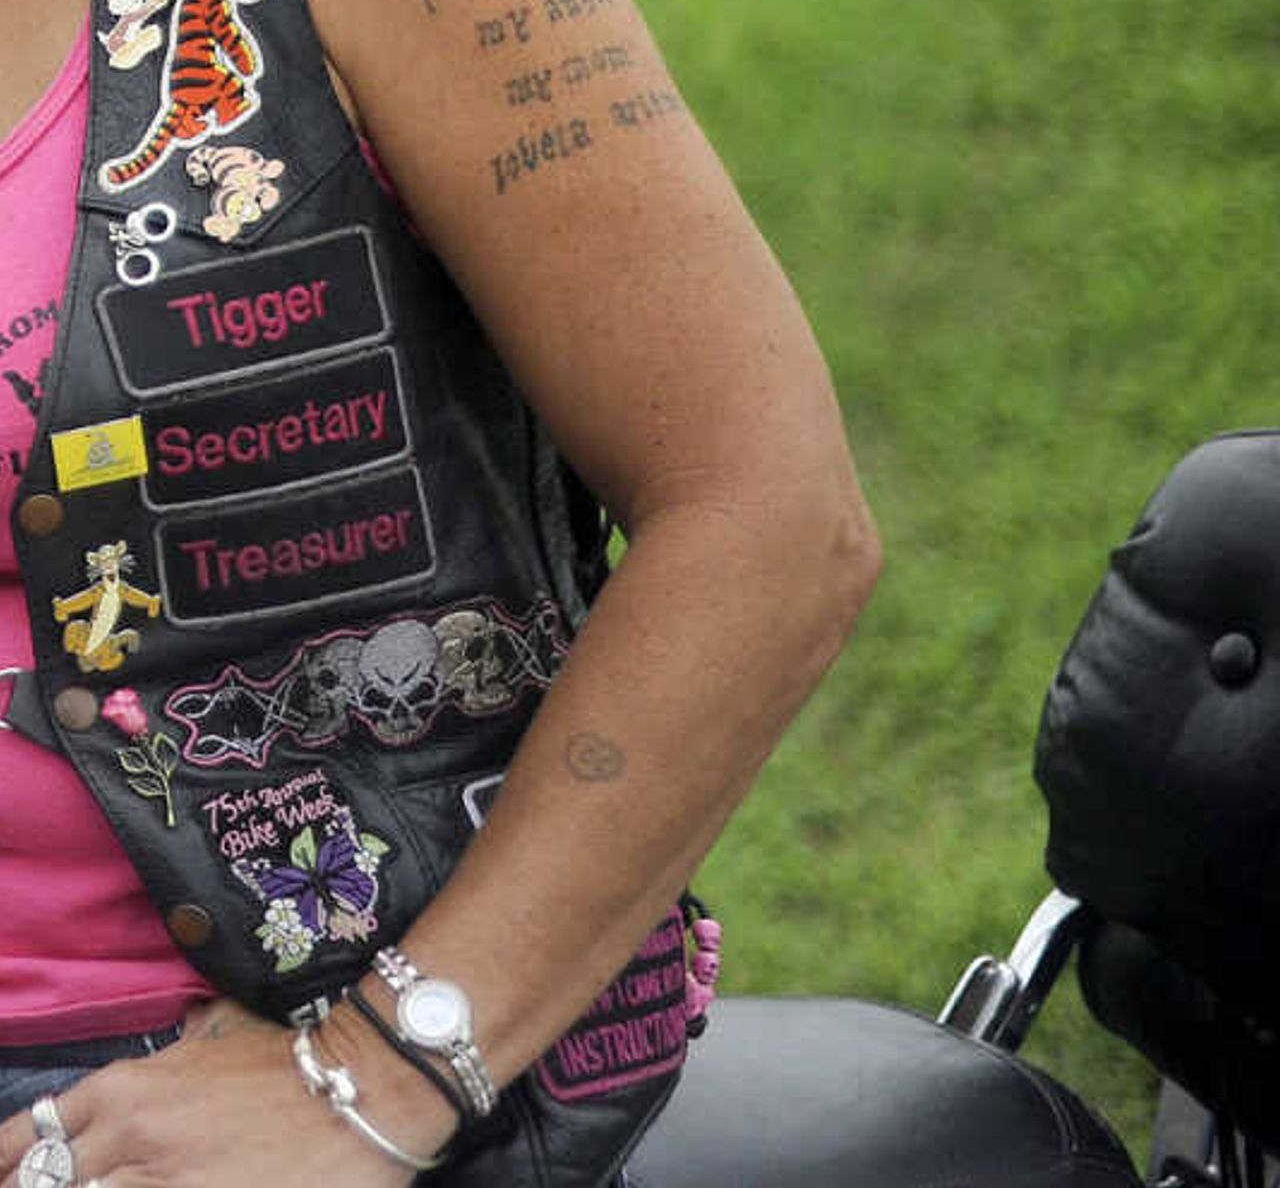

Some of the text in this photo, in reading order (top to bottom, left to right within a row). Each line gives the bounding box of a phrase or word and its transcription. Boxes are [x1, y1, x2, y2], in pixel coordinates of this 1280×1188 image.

[167, 278, 330, 348] Tigger
[155, 390, 388, 475] Secretary
[180, 510, 412, 591] Treasurer
[202, 788, 259, 835] 75th
[220, 785, 339, 859] Bike Week
